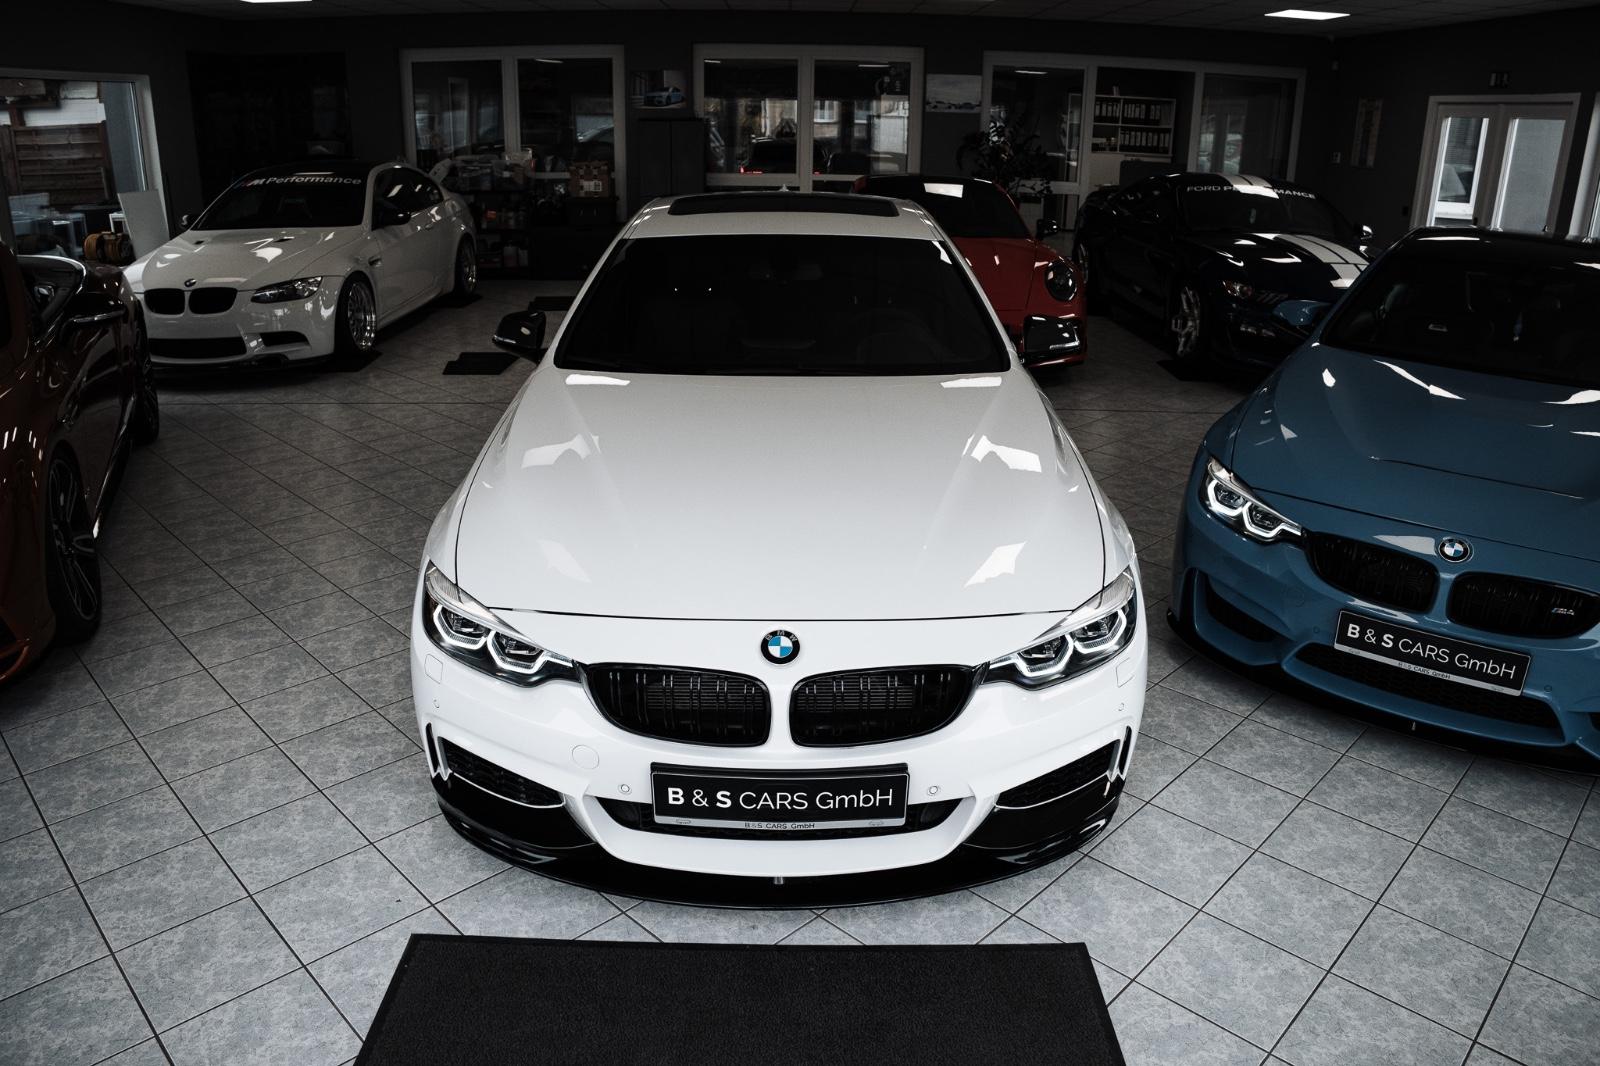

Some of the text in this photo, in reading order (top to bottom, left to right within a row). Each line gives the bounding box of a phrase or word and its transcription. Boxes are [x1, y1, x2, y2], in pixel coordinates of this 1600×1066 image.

[265, 175, 362, 185] Performance
[1223, 185, 1317, 200] PEMANCE
[764, 630, 798, 642] BMW
[1347, 623, 1516, 679] B & S CARS GmbH
[667, 787, 893, 810] B & S CARS GmbH
[790, 822, 815, 830] GmbH
